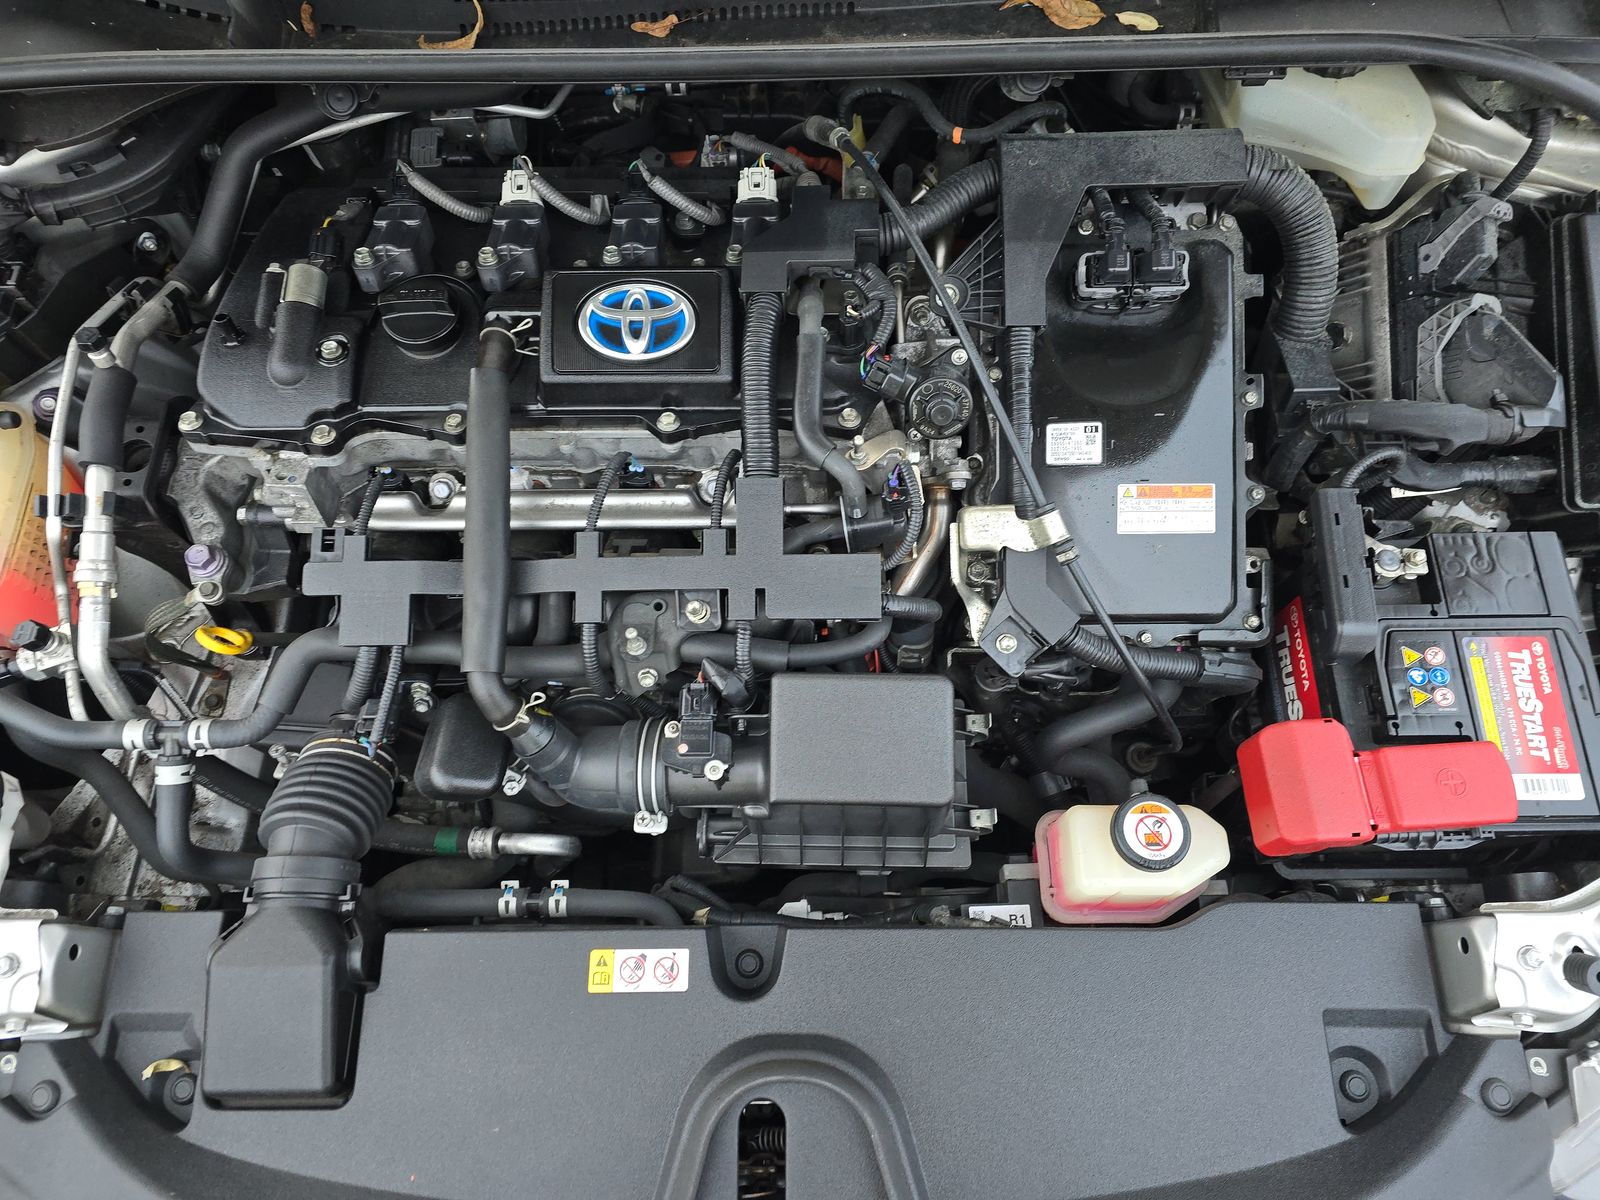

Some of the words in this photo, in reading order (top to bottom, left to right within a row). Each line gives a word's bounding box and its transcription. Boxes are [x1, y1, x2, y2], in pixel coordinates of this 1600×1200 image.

[943, 380, 963, 394] 25620
[961, 398, 970, 418] 37140
[1294, 628, 1310, 692] TOYOTA
[1536, 656, 1553, 695] TOYOTA
[1507, 649, 1550, 761] TRUESTART
[1509, 719, 1518, 733] CCA
[1008, 913, 1025, 924] R1
